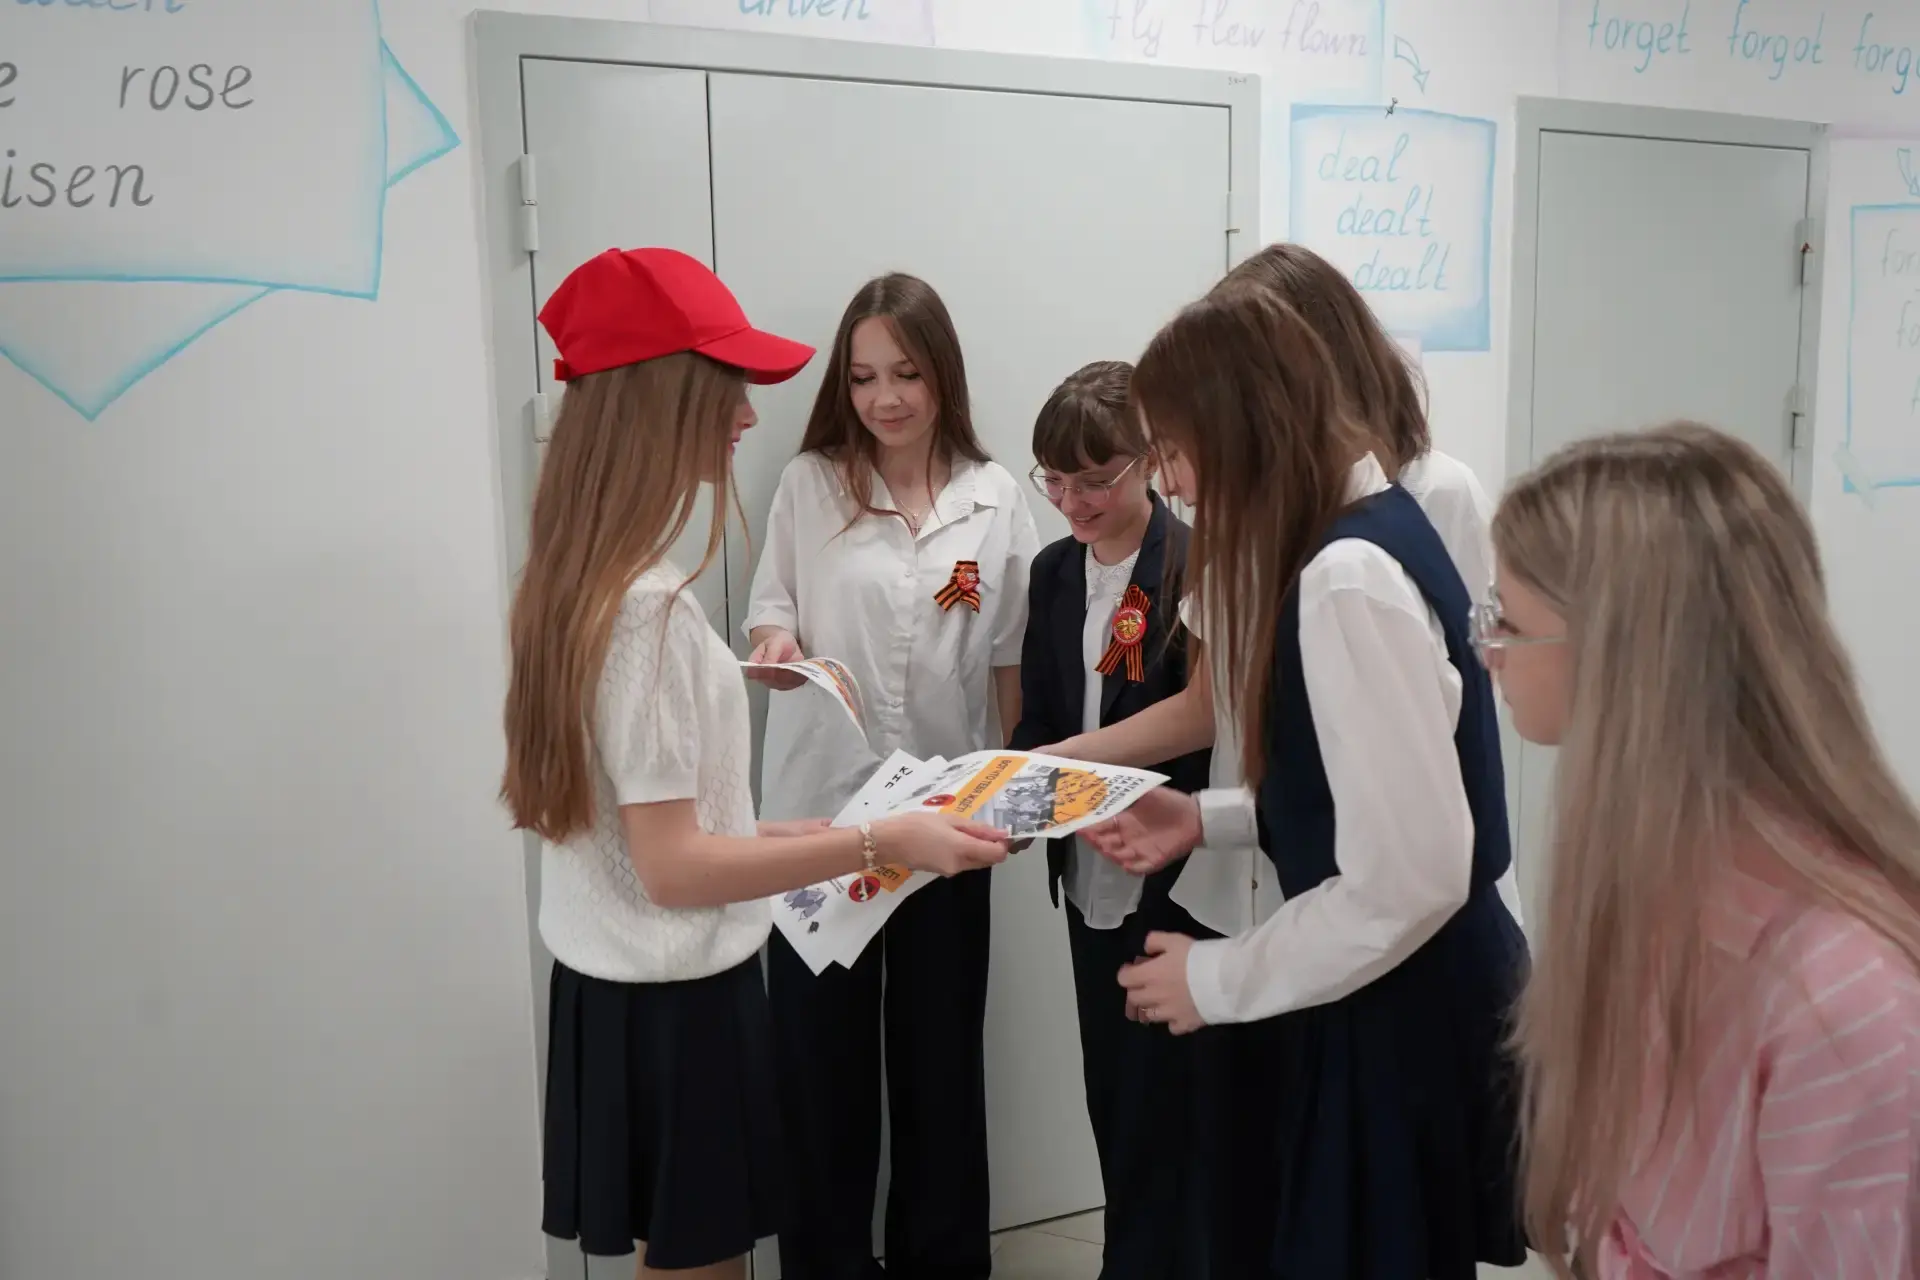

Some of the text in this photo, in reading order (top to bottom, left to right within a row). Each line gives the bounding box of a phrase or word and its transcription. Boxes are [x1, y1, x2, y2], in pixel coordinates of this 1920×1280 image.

[1107, 0, 1369, 58] fly flew flown
[1588, 0, 1920, 94] forget forgot forg
[119, 64, 254, 110] rose
[1318, 127, 1410, 182] deal
[1337, 184, 1434, 237] dealt
[1354, 242, 1452, 290] dealt
